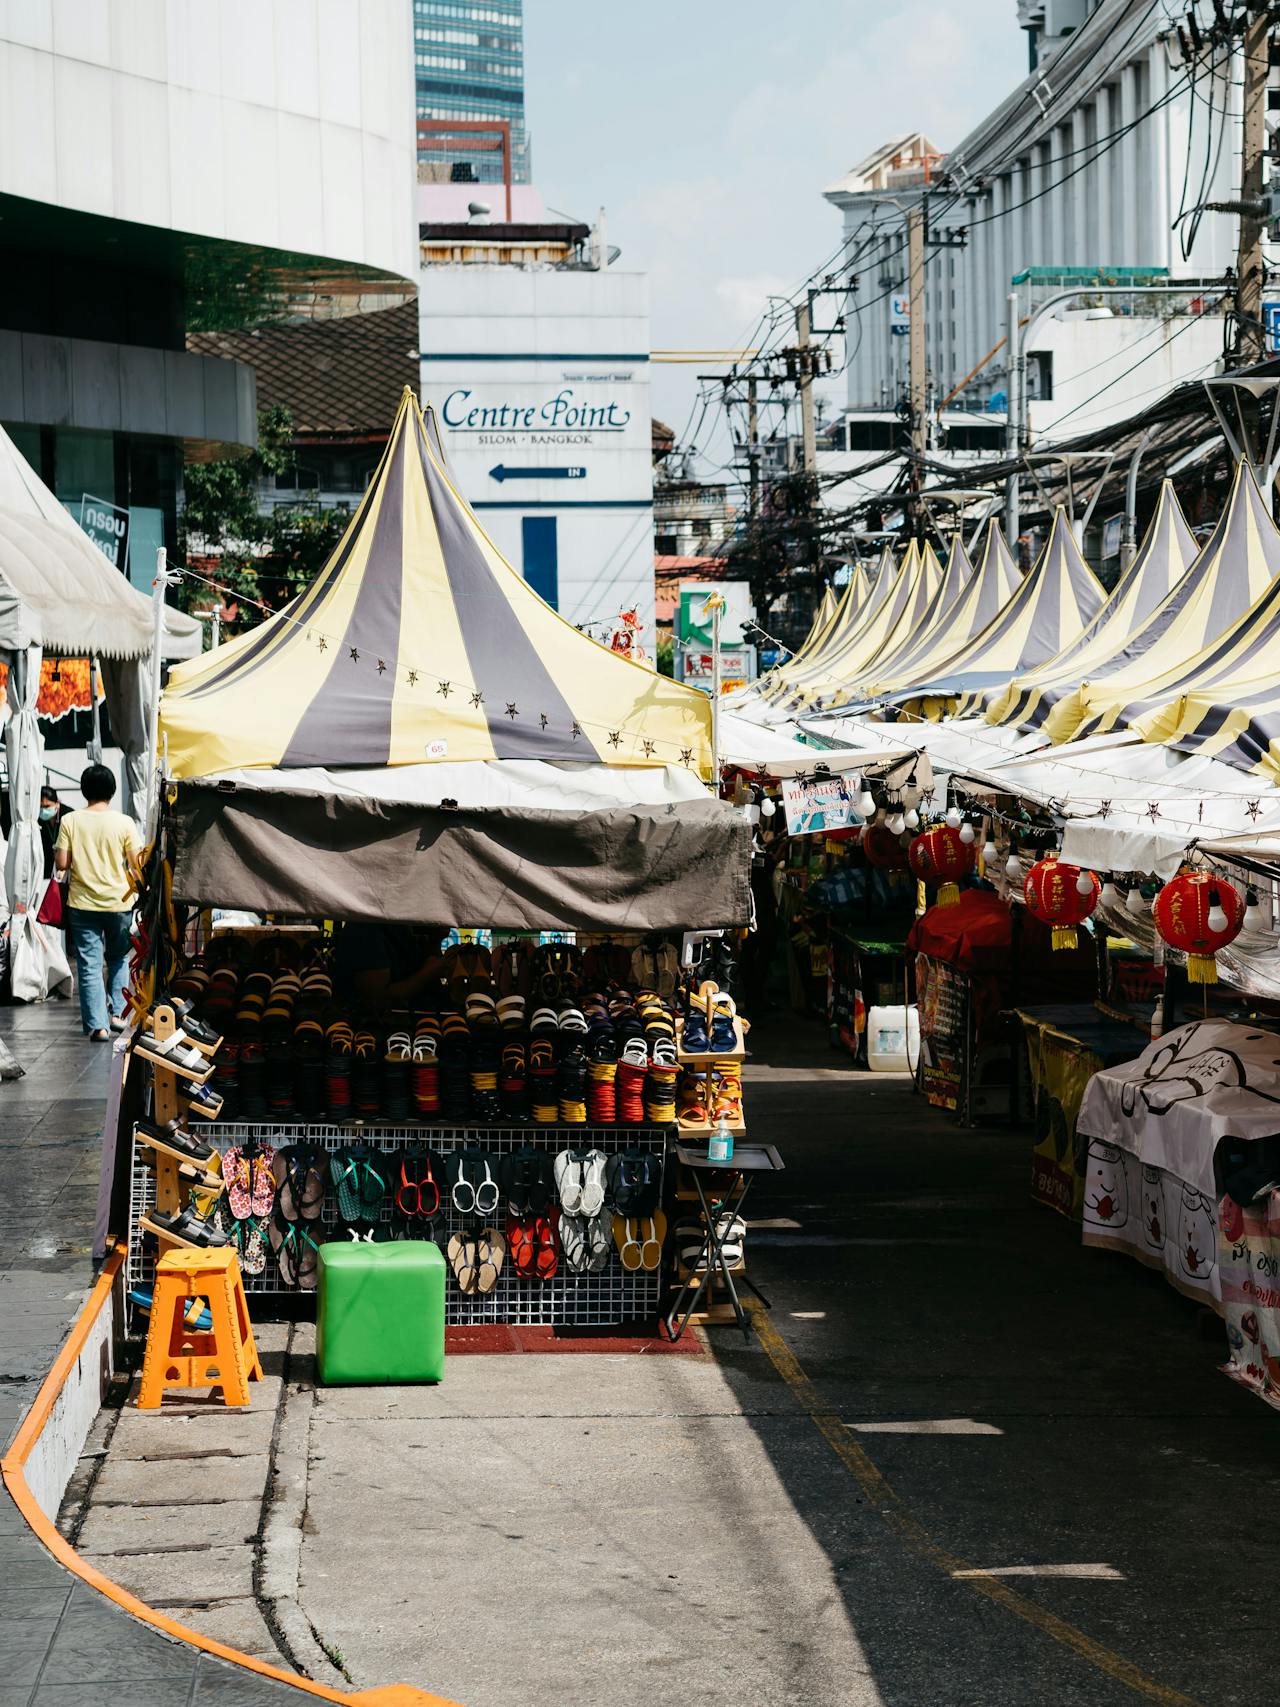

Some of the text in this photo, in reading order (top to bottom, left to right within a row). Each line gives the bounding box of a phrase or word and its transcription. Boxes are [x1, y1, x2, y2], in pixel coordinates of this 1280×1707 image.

[442, 389, 630, 428] Centre Point
[478, 434, 594, 445] SILOM BANGKOK
[567, 467, 581, 478] IN
[86, 508, 126, 538] กรอบ
